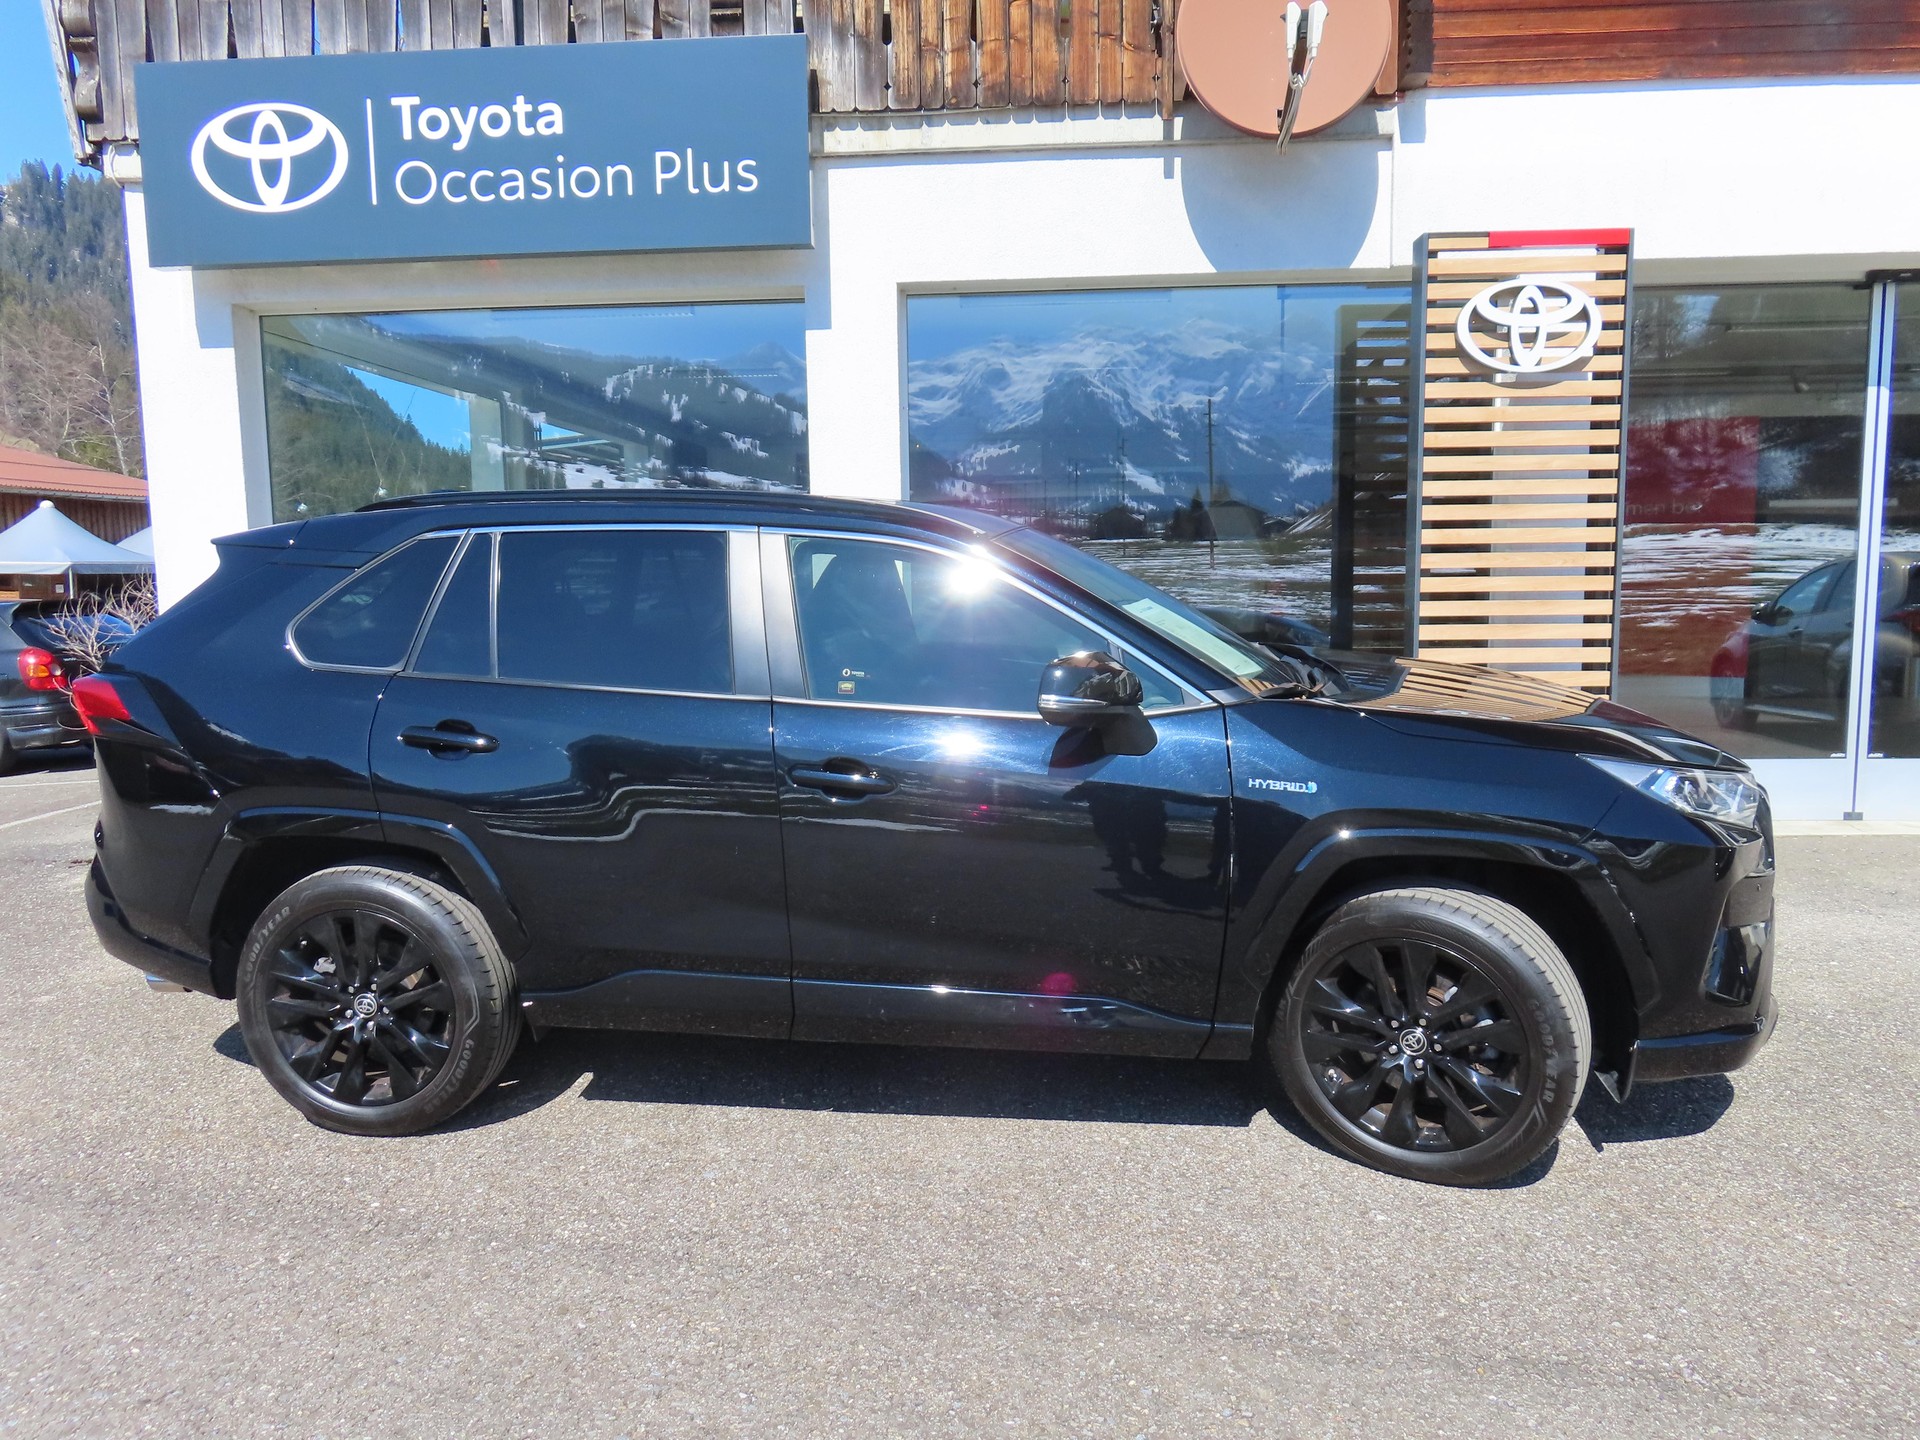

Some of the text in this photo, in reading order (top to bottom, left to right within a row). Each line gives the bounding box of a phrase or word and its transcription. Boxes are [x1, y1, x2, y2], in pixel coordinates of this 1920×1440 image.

[390, 94, 564, 151] Toyota
[394, 148, 760, 206] Occasion Plus
[1247, 778, 1307, 793] HYBRID
[244, 906, 290, 982] GOODYEAR
[1529, 998, 1559, 1103] GOODYEAR
